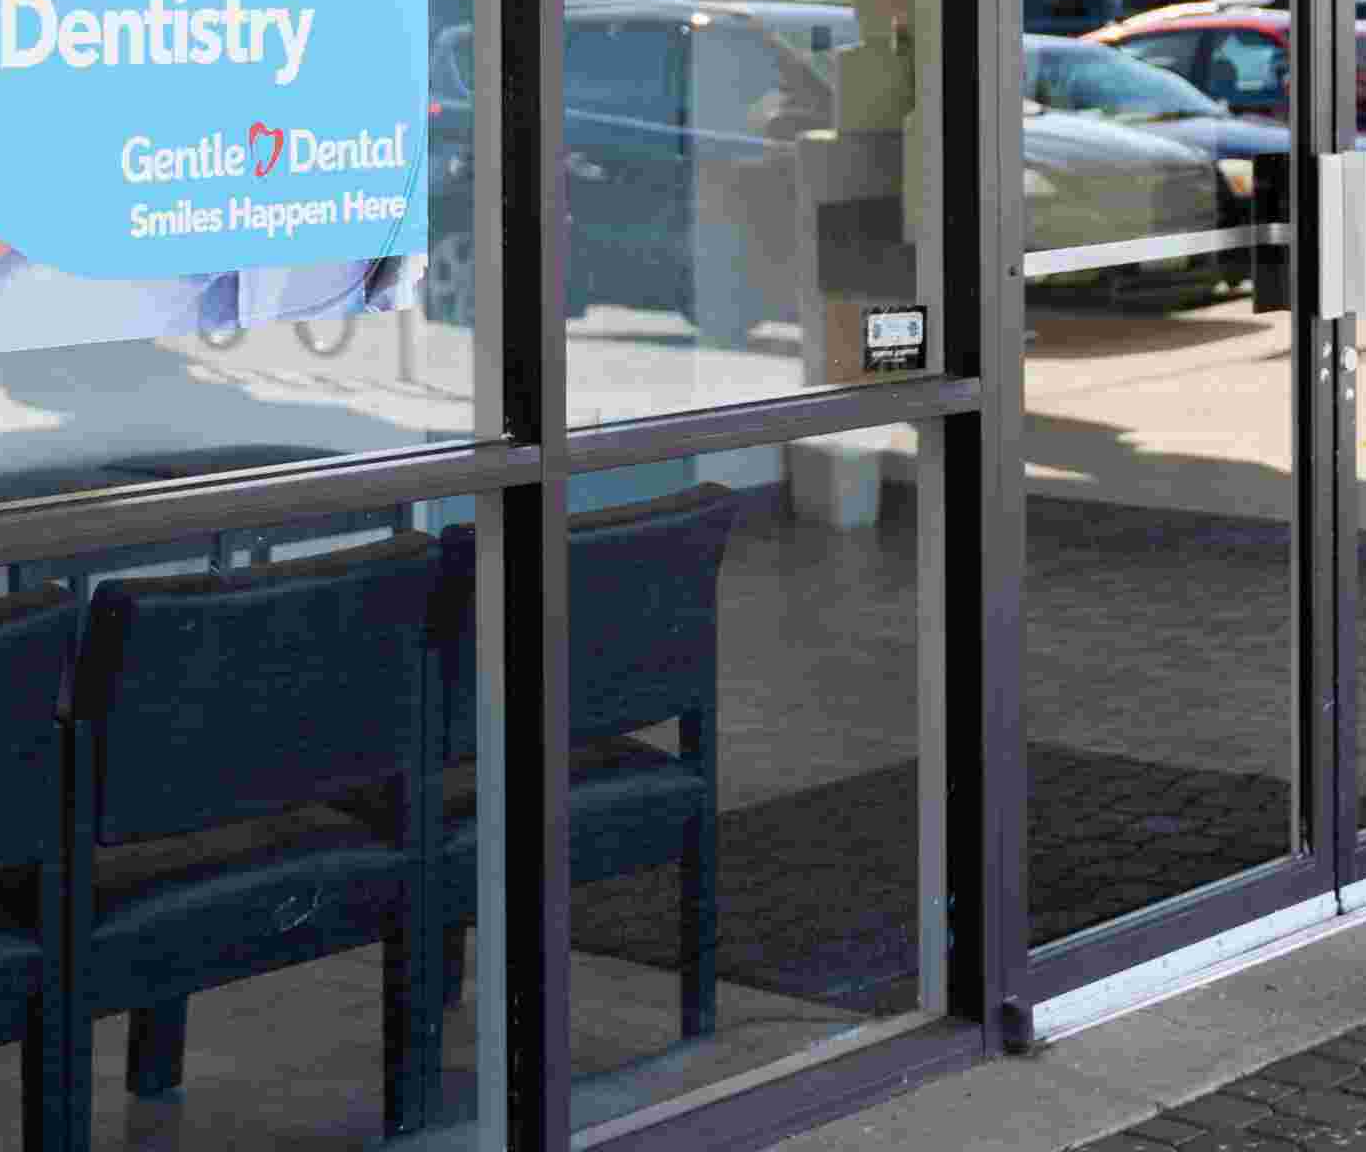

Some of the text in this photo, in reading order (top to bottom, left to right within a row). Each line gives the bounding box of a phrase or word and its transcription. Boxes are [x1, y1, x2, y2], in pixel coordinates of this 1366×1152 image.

[122, 123, 409, 184] Gentle Dental
[130, 190, 407, 239] Smiles Happen Here
